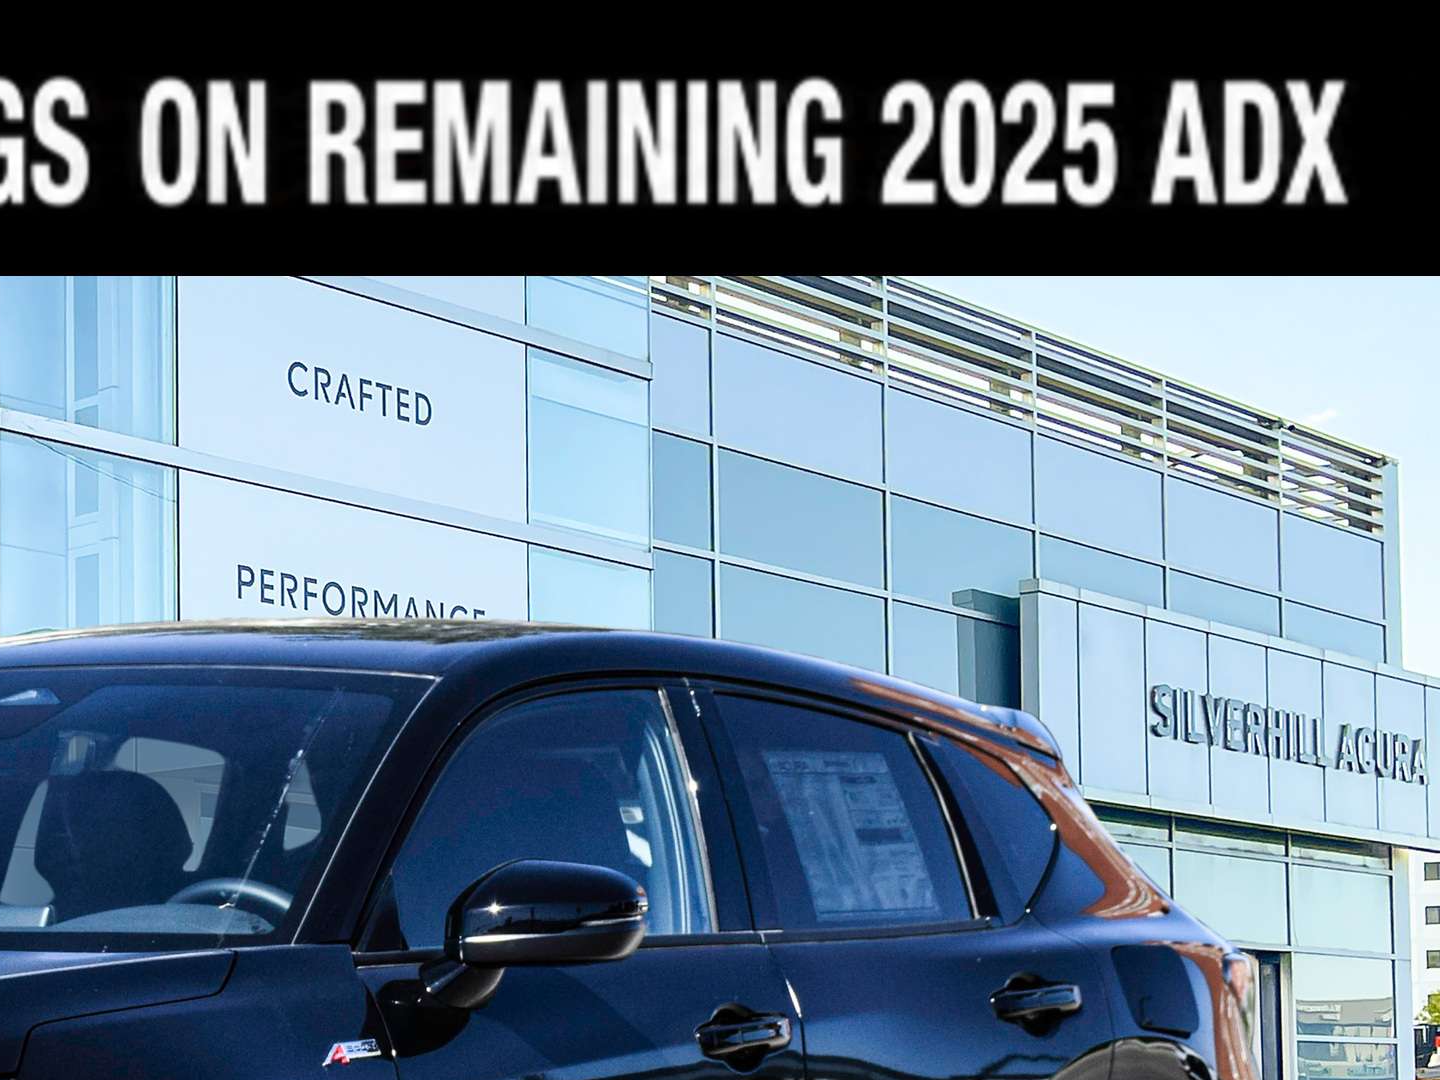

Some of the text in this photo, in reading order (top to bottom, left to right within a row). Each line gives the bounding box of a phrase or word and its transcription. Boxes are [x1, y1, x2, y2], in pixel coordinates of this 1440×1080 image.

[287, 361, 433, 426] CRAFTED
[237, 564, 486, 619] PERFORMAN
[1149, 684, 1429, 785] SILVERHILL ACURA
